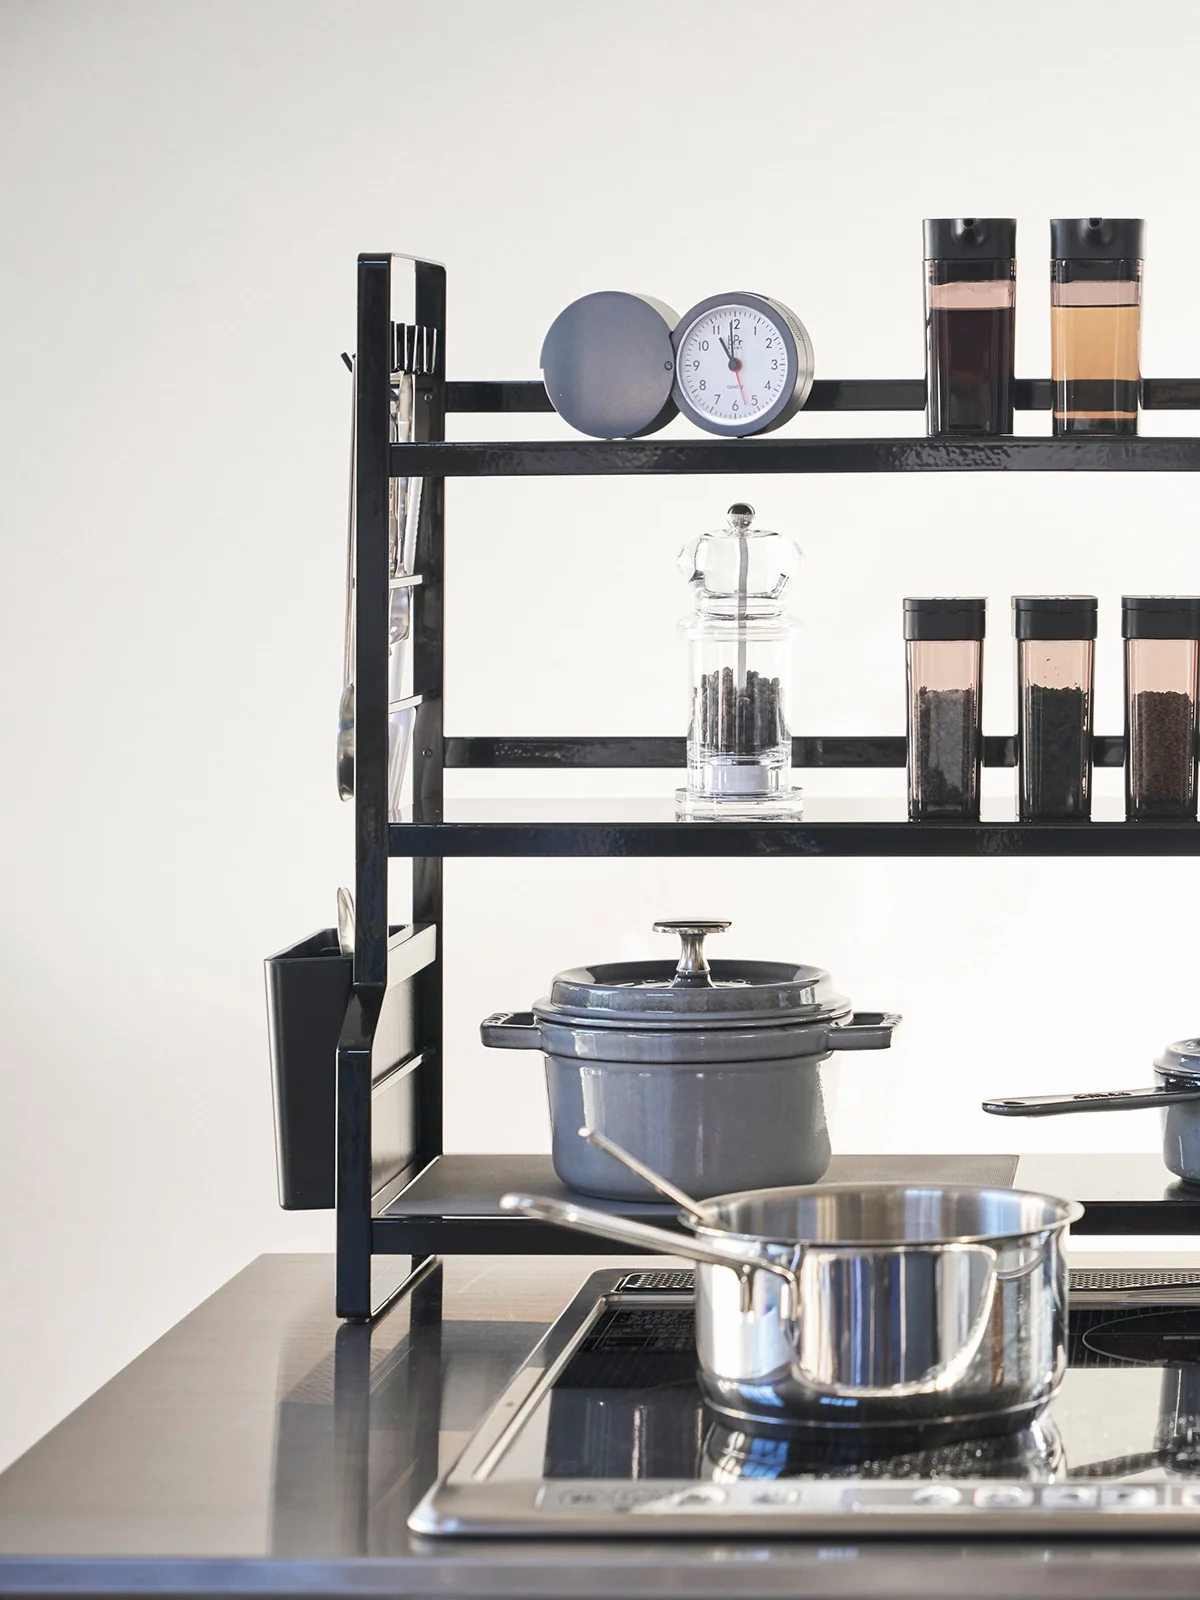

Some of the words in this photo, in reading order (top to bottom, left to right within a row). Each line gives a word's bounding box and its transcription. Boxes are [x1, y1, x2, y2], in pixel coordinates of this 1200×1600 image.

[713, 325, 720, 335] 11
[754, 326, 757, 335] 1
[698, 340, 709, 351] 10
[766, 338, 773, 348] 2
[693, 360, 700, 371] 9
[771, 359, 778, 370] 3
[699, 380, 706, 390] 8
[764, 380, 771, 390] 4
[714, 394, 721, 405] 7
[751, 395, 758, 406] 5
[732, 400, 739, 411] 6
